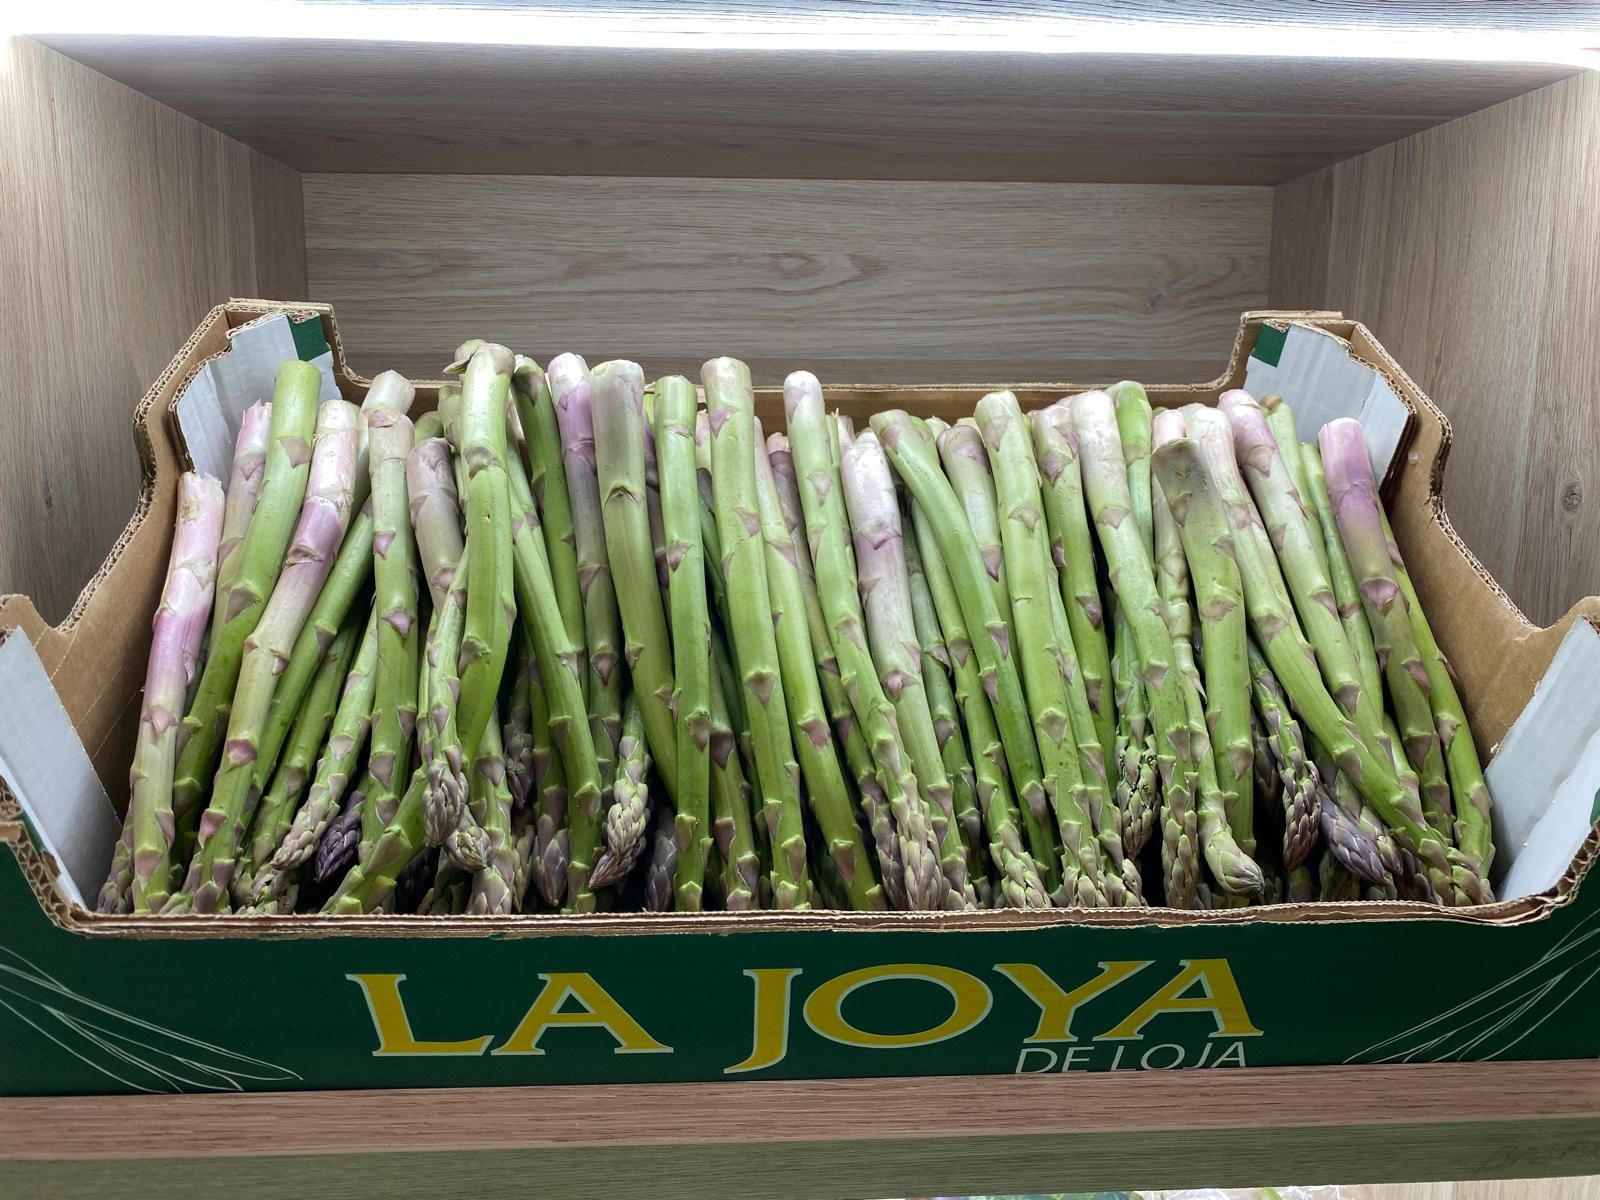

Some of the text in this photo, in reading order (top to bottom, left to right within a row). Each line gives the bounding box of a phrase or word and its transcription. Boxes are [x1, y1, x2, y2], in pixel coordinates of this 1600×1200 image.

[345, 958, 1264, 1074] LA JOYA
[1015, 1041, 1248, 1073] DE LOJA
